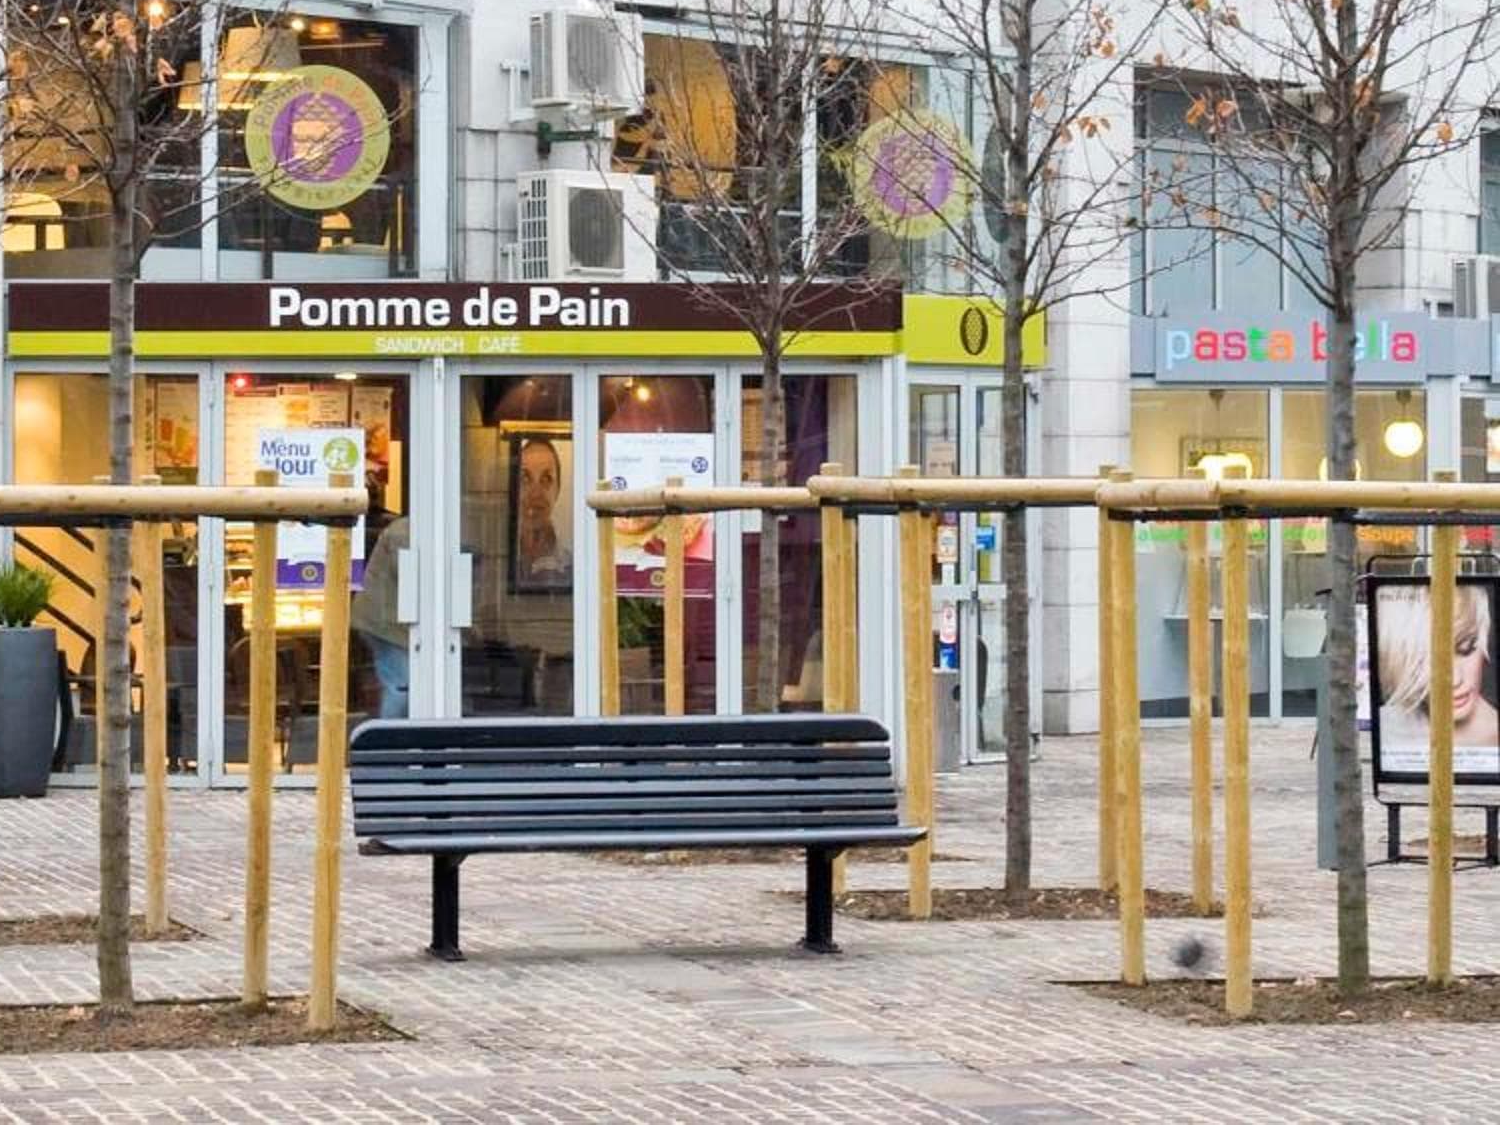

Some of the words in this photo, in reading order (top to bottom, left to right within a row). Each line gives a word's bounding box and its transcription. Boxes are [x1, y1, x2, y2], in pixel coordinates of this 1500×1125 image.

[269, 287, 450, 326] Pomme
[463, 287, 518, 326] de
[530, 287, 629, 326] Pain
[375, 336, 464, 354] SANDWICH
[1166, 328, 1295, 370] pasta
[261, 441, 310, 457] Menu
